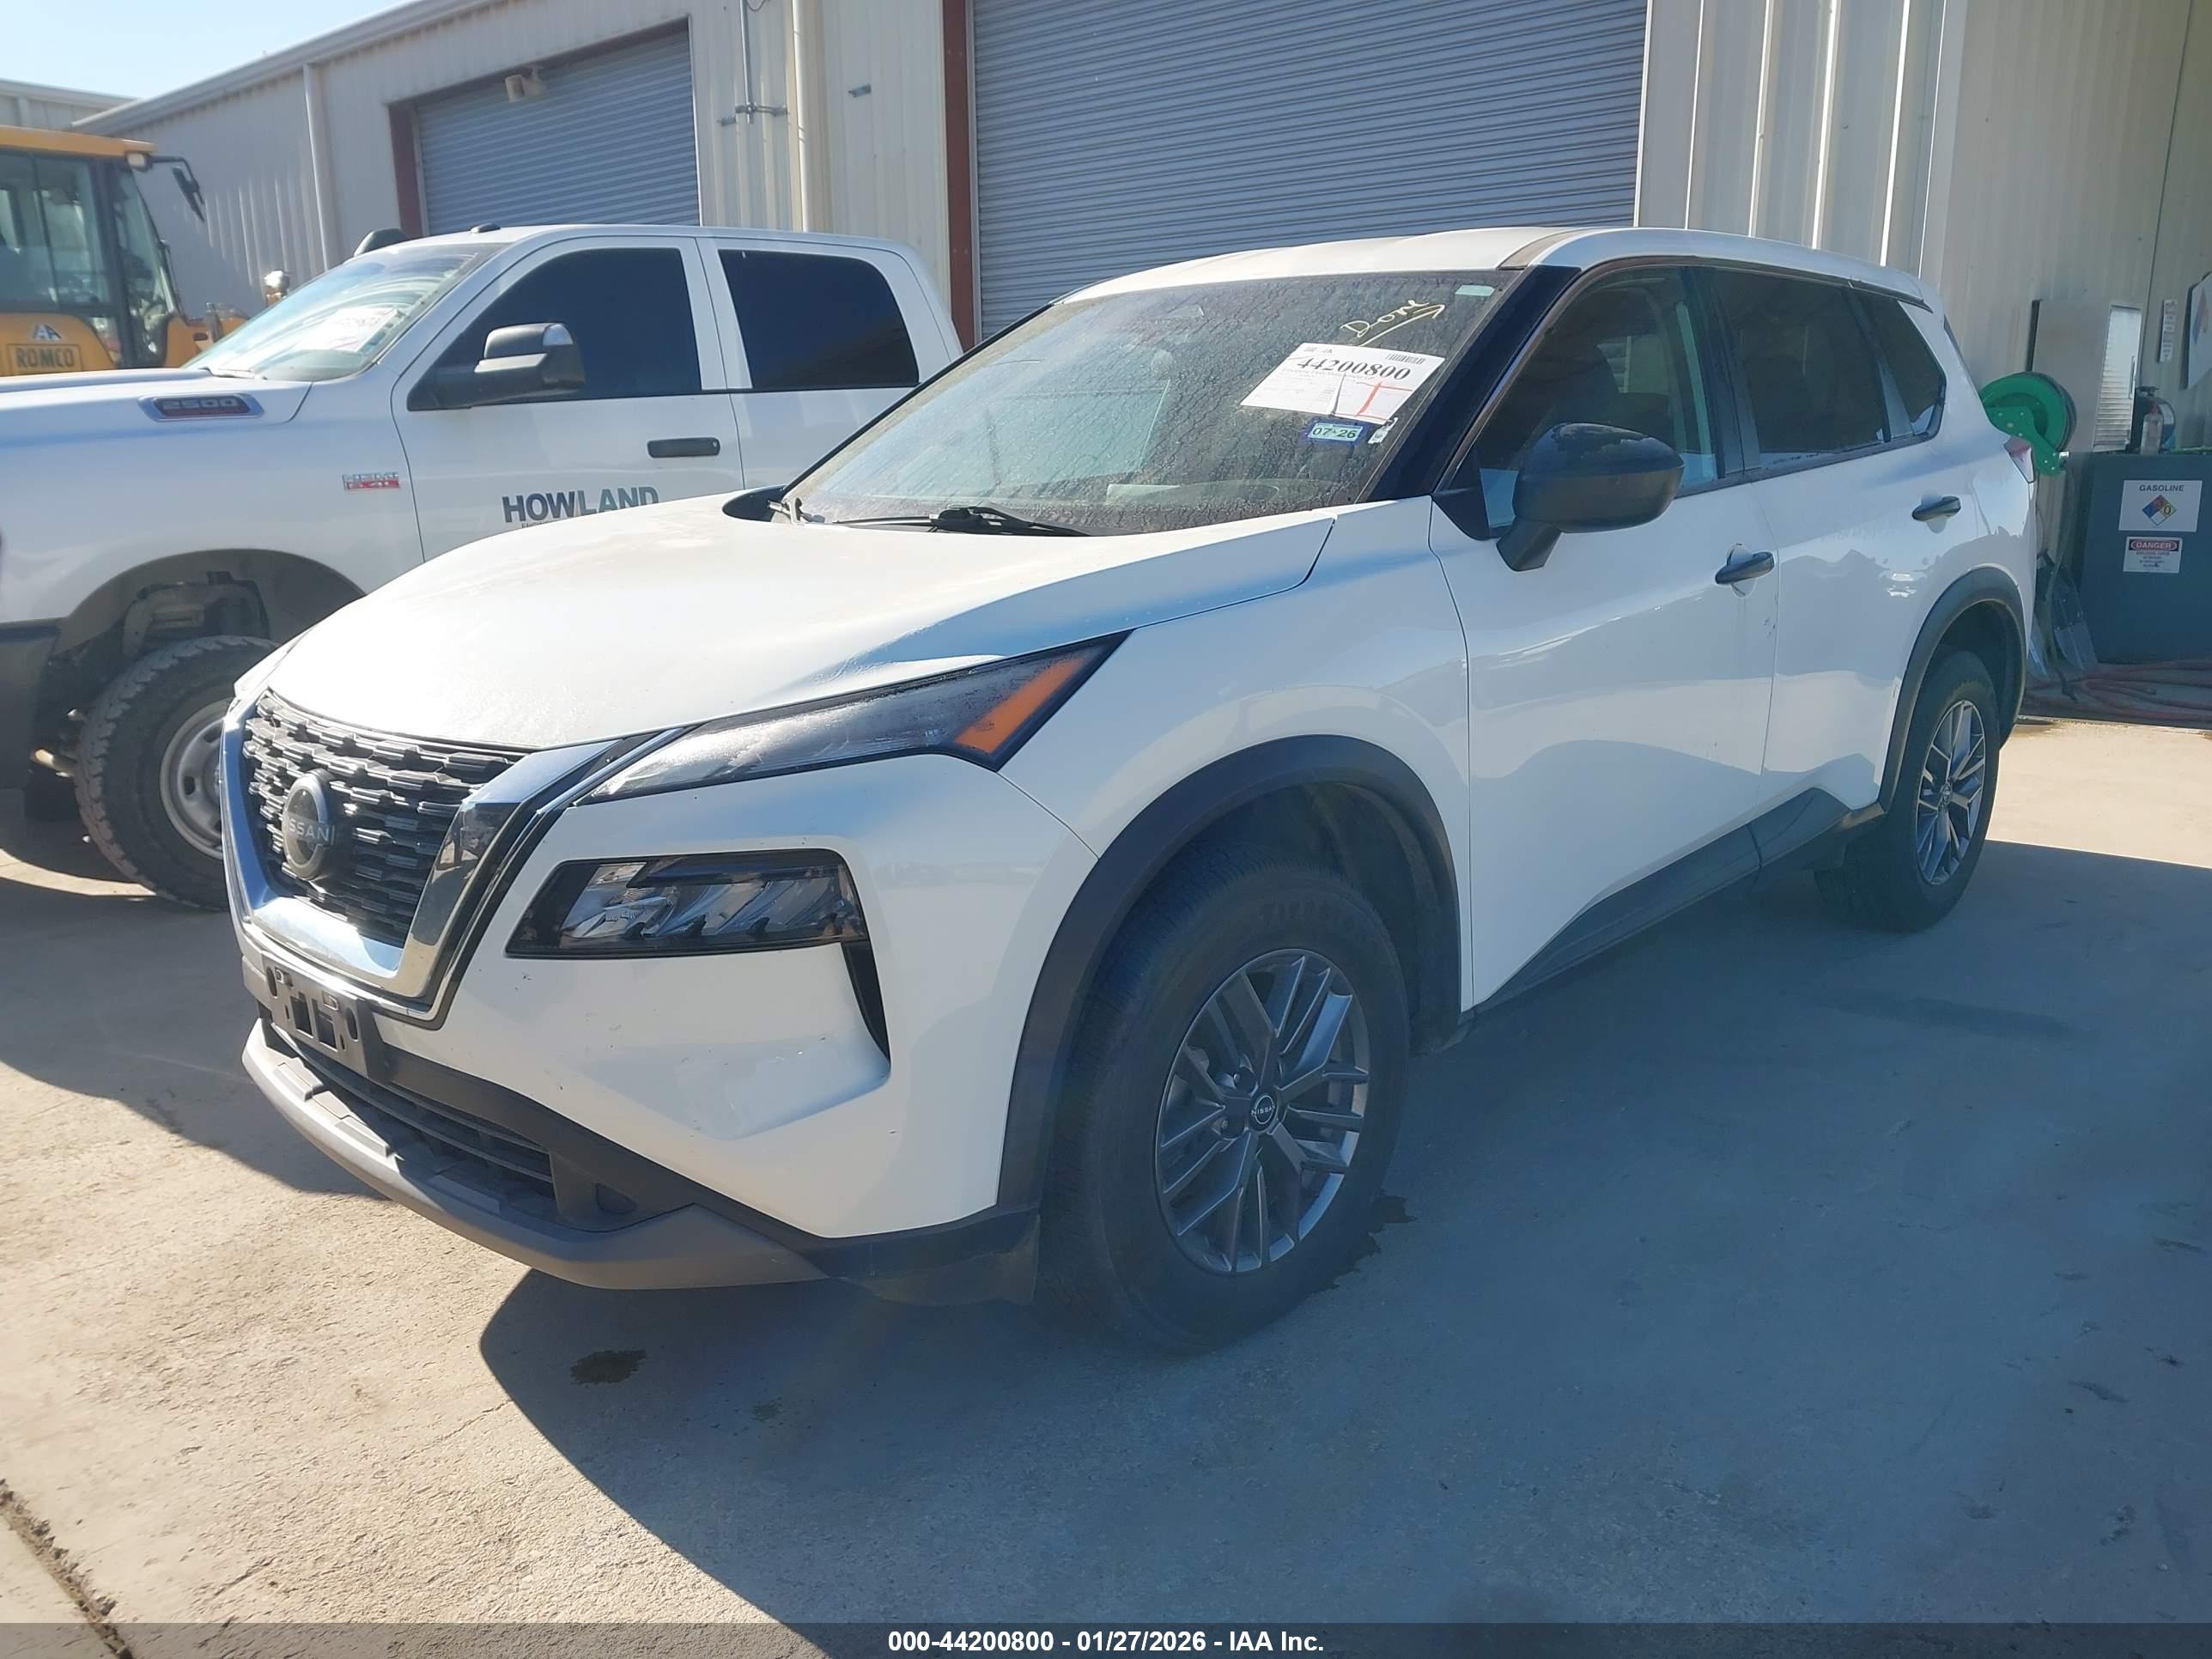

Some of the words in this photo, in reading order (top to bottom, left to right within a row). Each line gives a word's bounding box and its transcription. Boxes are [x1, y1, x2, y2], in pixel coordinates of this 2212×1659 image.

[1297, 357, 1411, 380] 44200800
[162, 398, 238, 410] 2500
[1312, 427, 1333, 435] 07
[1337, 429, 1357, 438] 26
[502, 486, 659, 523] HOWLAND
[283, 814, 330, 842] SSAN
